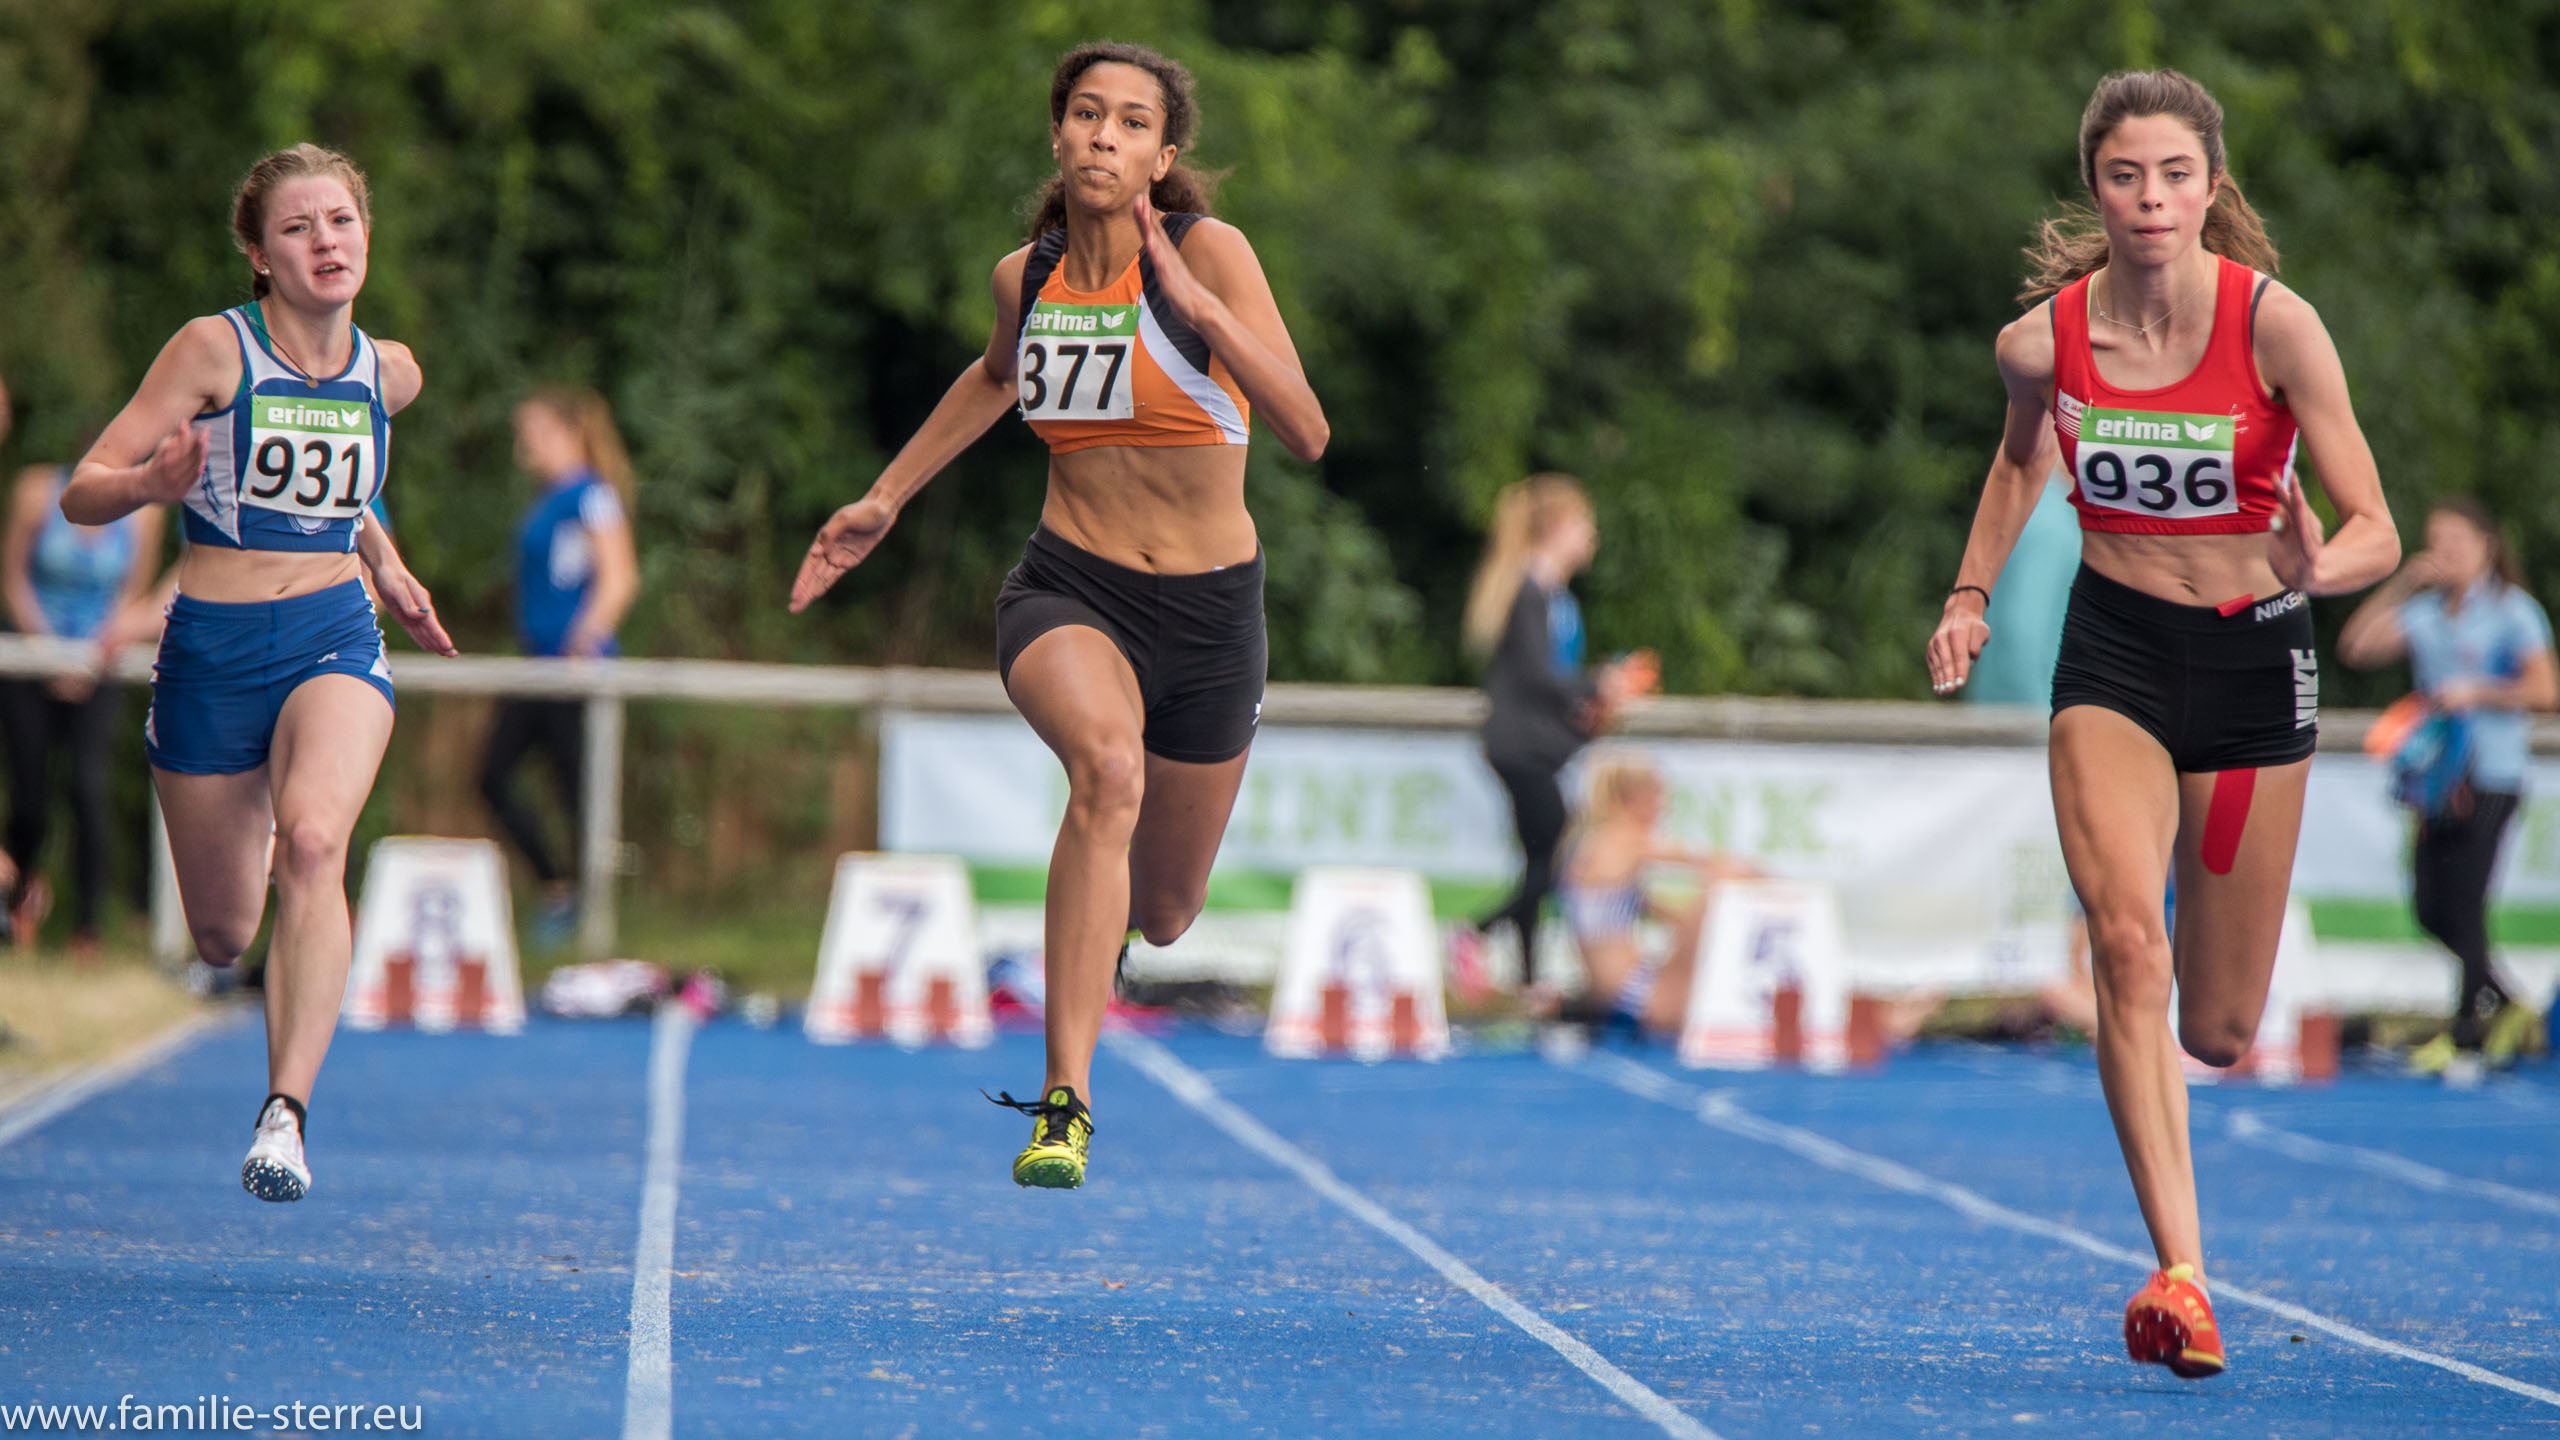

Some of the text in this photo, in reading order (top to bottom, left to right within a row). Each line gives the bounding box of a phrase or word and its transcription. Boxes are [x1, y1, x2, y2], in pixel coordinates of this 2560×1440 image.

[1030, 309, 1098, 331] erima
[1022, 342, 1127, 411] 377
[268, 404, 339, 427] erima
[2096, 416, 2180, 441] erima
[250, 435, 362, 507] 931
[2085, 450, 2228, 511] 936
[2254, 591, 2299, 622] NIKE
[2290, 648, 2319, 729] NIKE
[872, 890, 933, 987] 7
